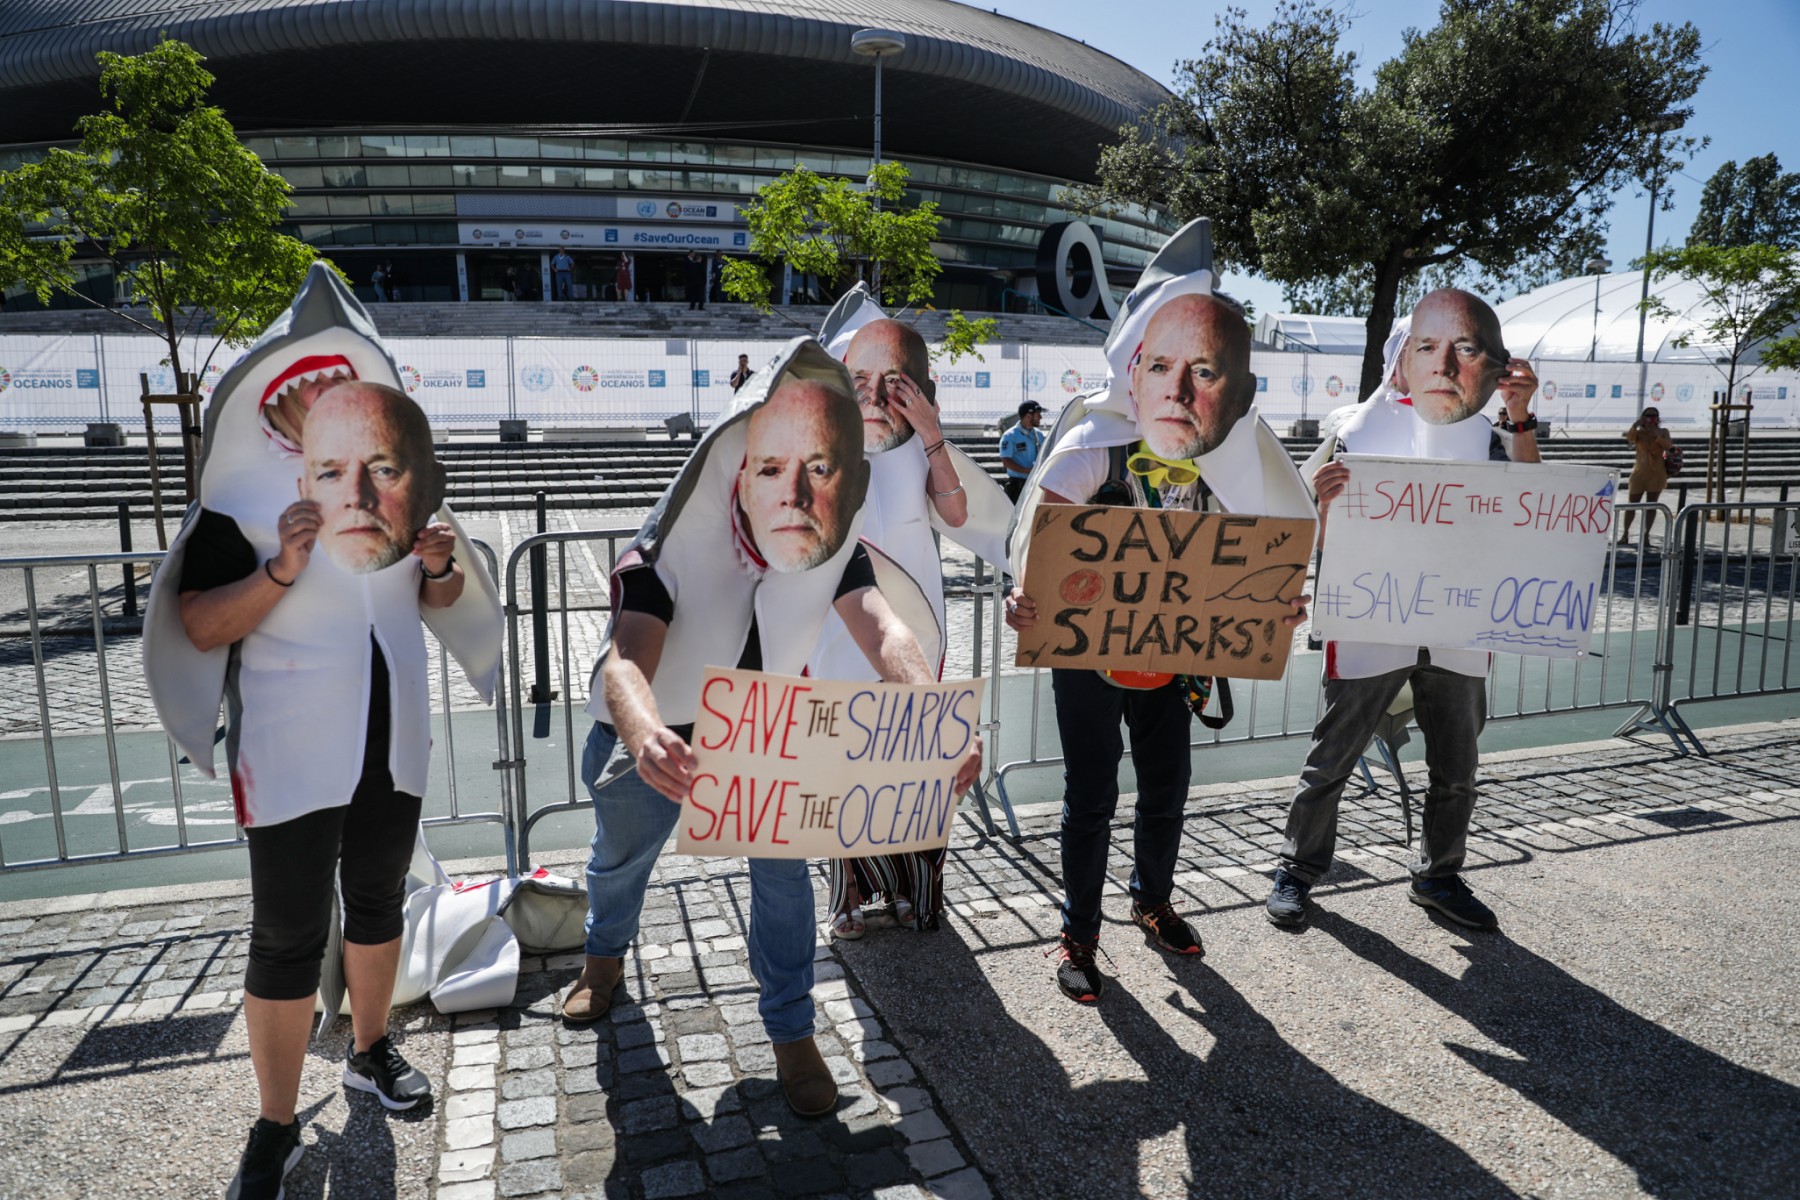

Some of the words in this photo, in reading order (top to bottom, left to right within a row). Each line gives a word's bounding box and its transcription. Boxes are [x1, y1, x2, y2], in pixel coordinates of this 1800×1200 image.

[633, 233, 719, 245] #SaveOurOcean
[423, 380, 463, 388] ОКЕАНУ
[600, 380, 645, 388] OCEANOS
[940, 374, 972, 383] OCEAN
[1338, 480, 1465, 526] #SAVE
[1465, 494, 1503, 514] THE
[1513, 491, 1612, 534] SHARKS
[1070, 508, 1258, 567] SAVE
[1319, 572, 1441, 625] #SAVE
[1443, 588, 1483, 609] THE
[1490, 576, 1594, 632] OCEAN
[1052, 608, 1277, 664] SHARKS!
[701, 677, 812, 760] SAVE
[807, 699, 842, 738] THE
[846, 690, 975, 762] SHARKS
[688, 774, 800, 845] SAVE
[799, 794, 840, 830] THE
[837, 776, 956, 849] OCEAN
